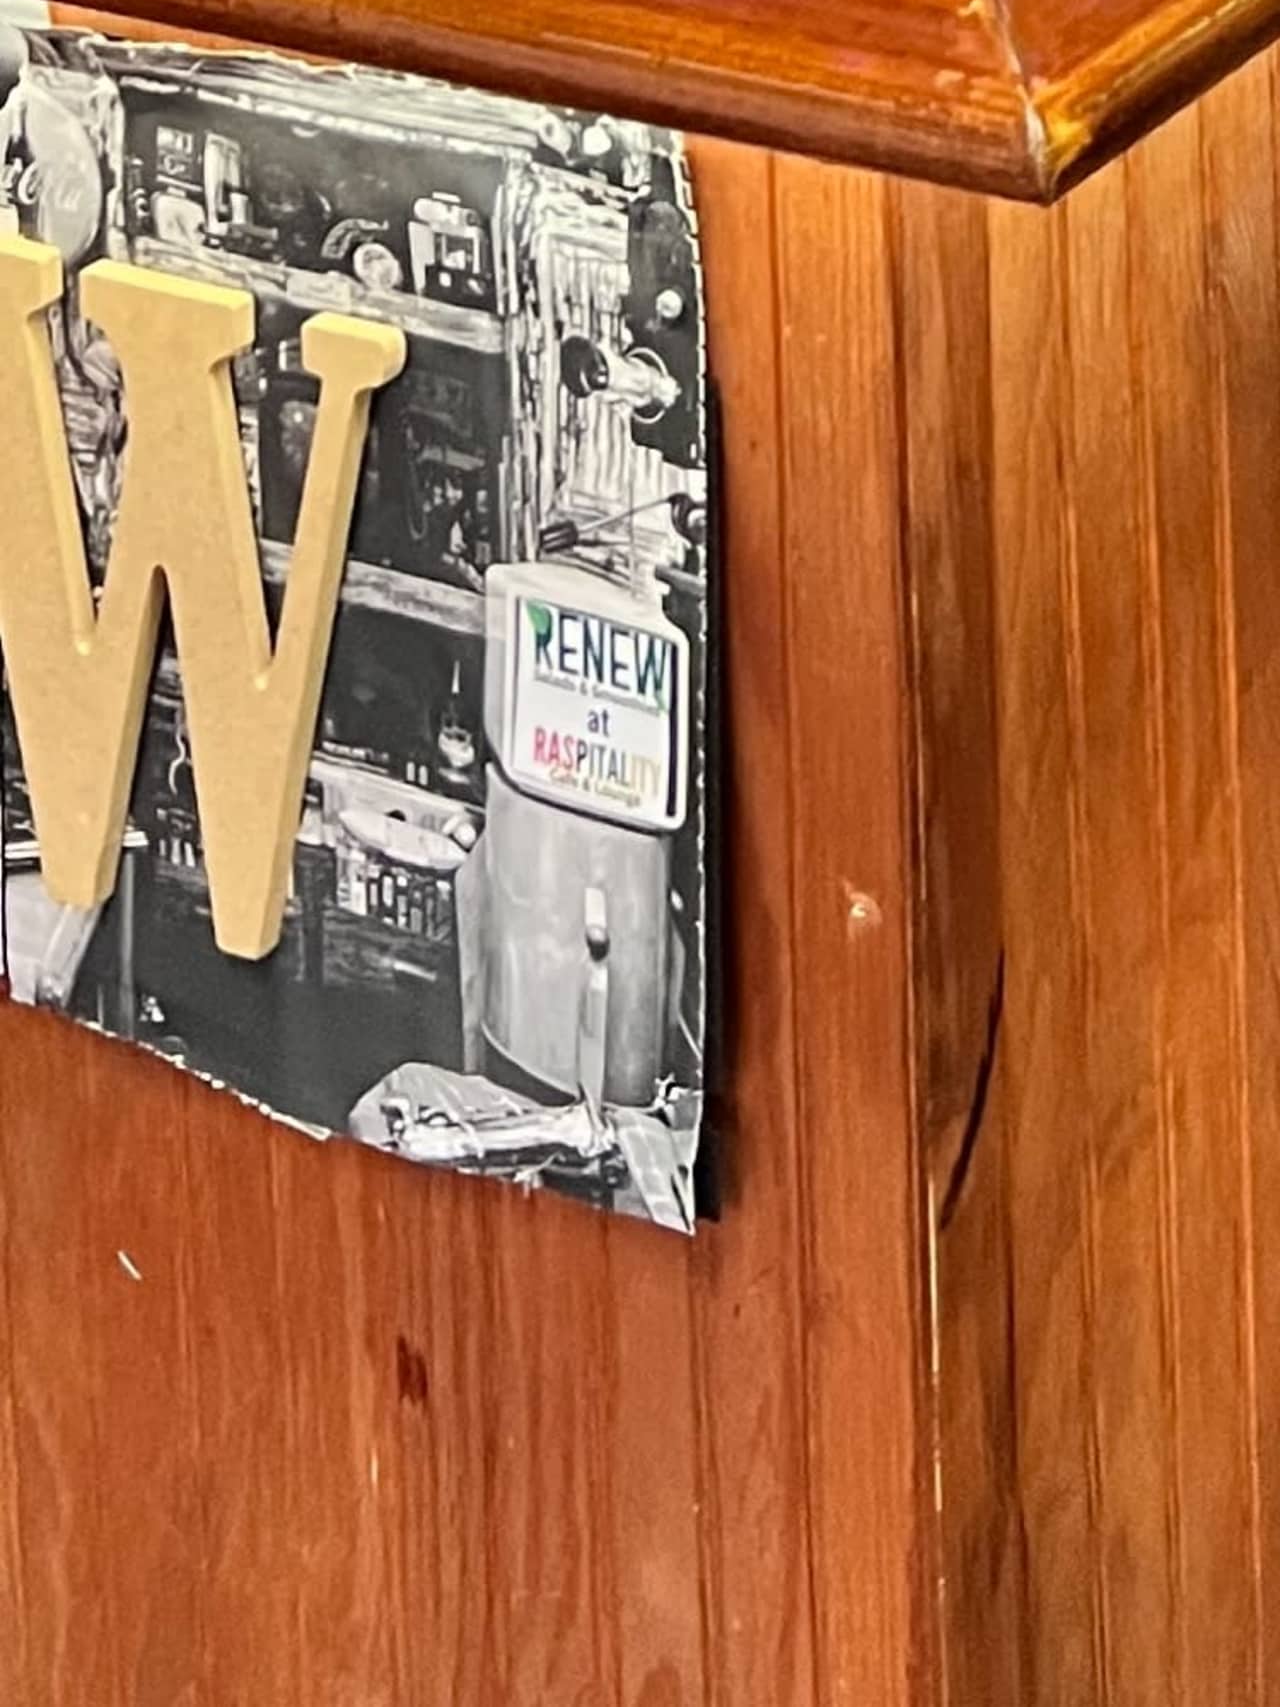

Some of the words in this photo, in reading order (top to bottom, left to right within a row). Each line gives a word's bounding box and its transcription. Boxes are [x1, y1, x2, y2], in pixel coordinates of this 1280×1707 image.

[526, 600, 668, 708] RENEW
[587, 709, 611, 737] at
[534, 726, 662, 796] RASPITALITY
